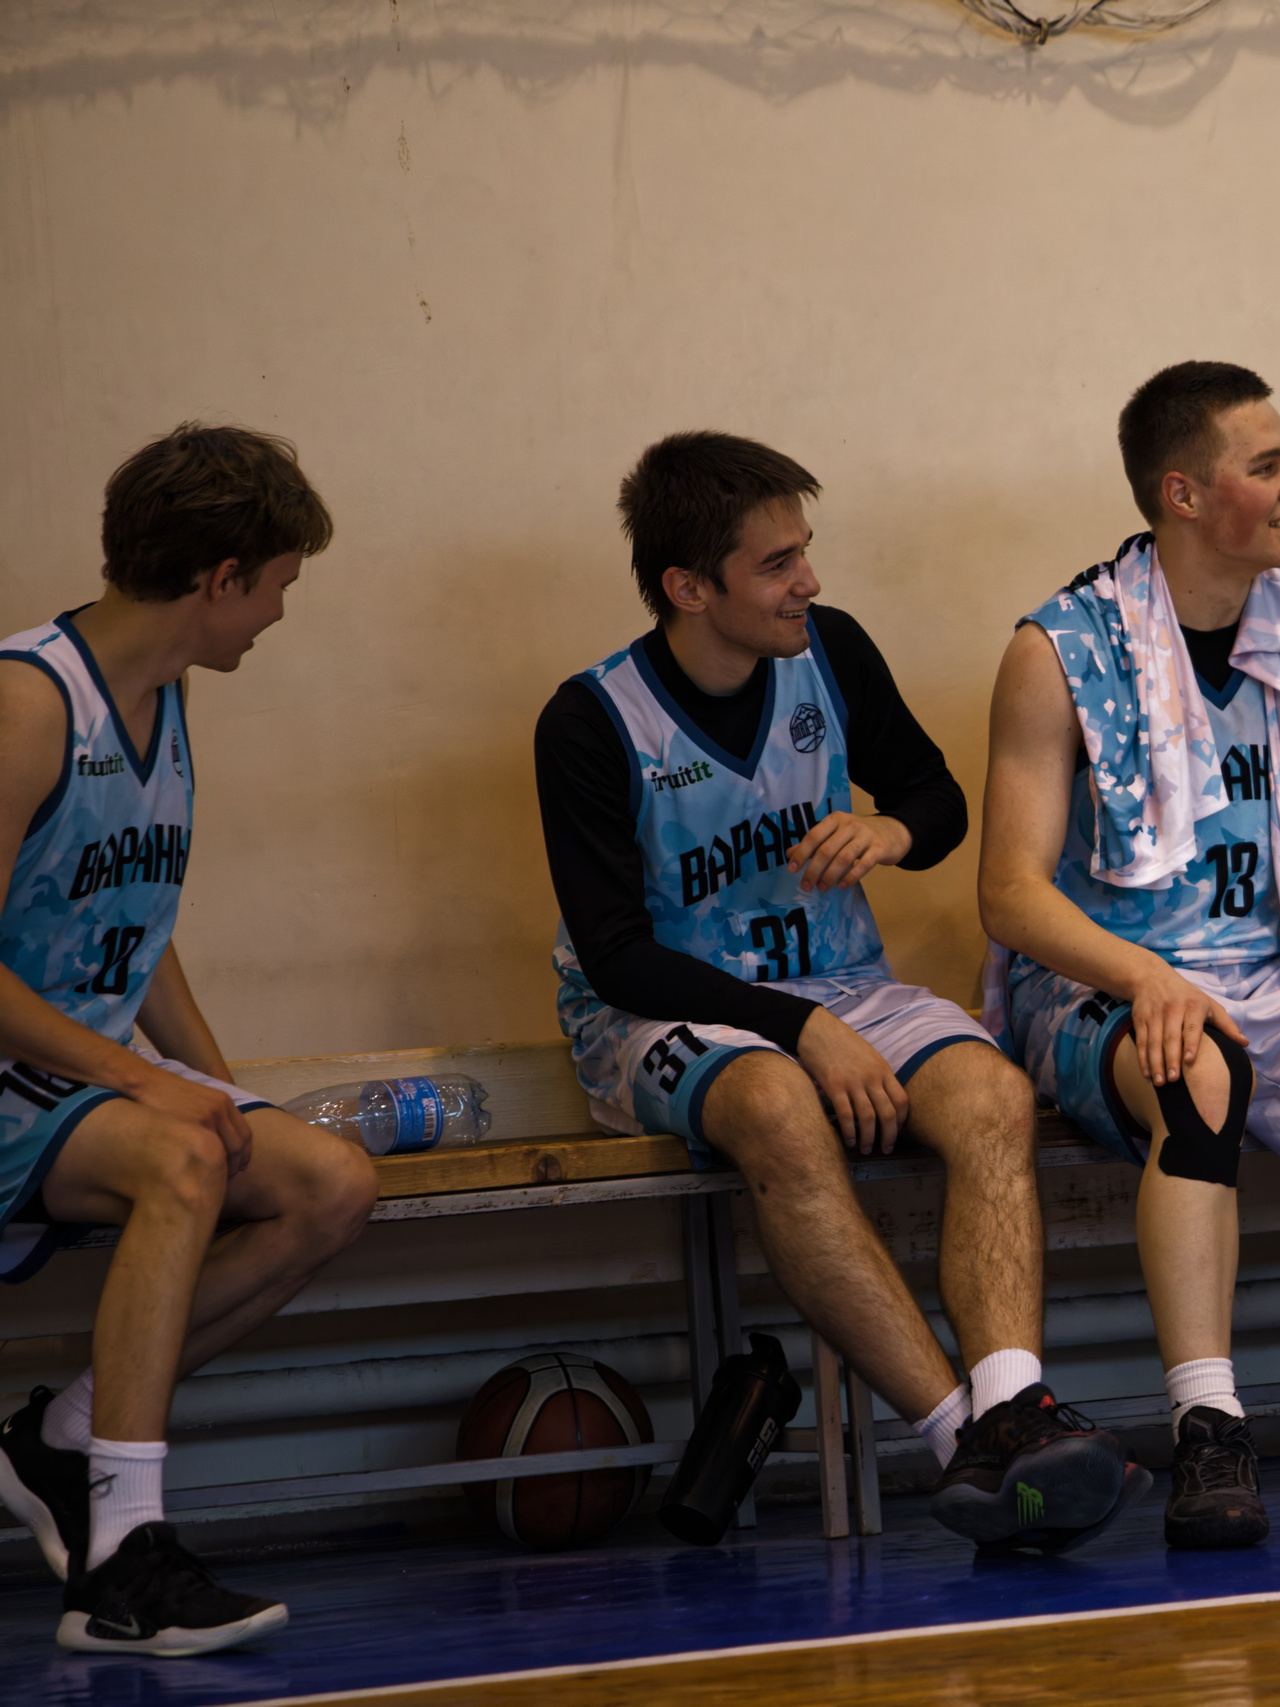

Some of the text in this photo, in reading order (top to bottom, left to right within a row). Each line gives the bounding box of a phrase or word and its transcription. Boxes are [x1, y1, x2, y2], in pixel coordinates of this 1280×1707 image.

[1206, 841, 1258, 918] 13
[750, 907, 811, 982] 31
[643, 1024, 709, 1095] 31
